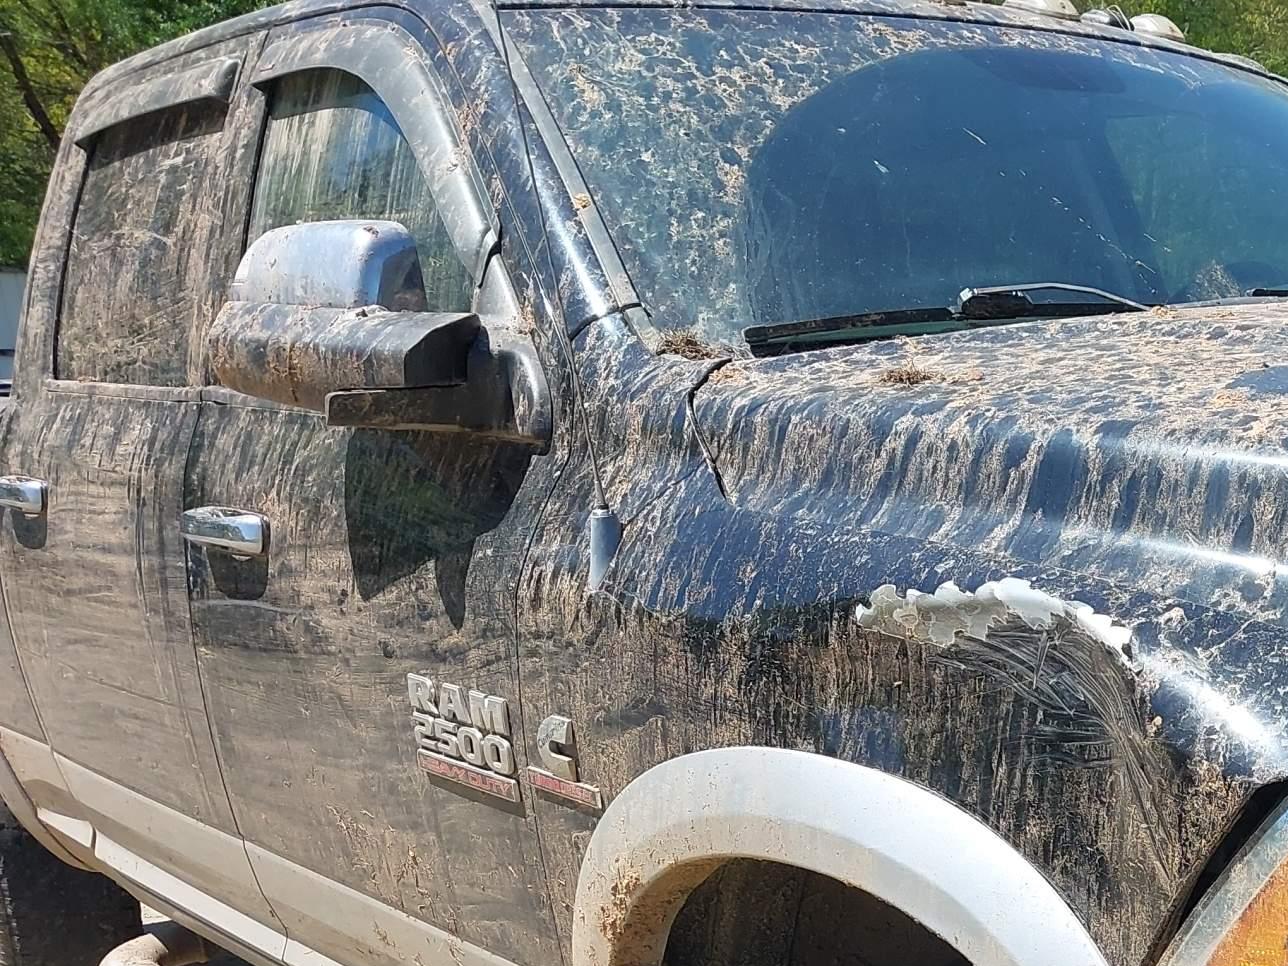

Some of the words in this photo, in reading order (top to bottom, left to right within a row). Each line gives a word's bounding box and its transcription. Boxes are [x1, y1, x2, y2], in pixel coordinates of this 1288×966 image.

[407, 673, 510, 736] RAM
[412, 711, 516, 776] 2500
[467, 772, 512, 796] DUTY
